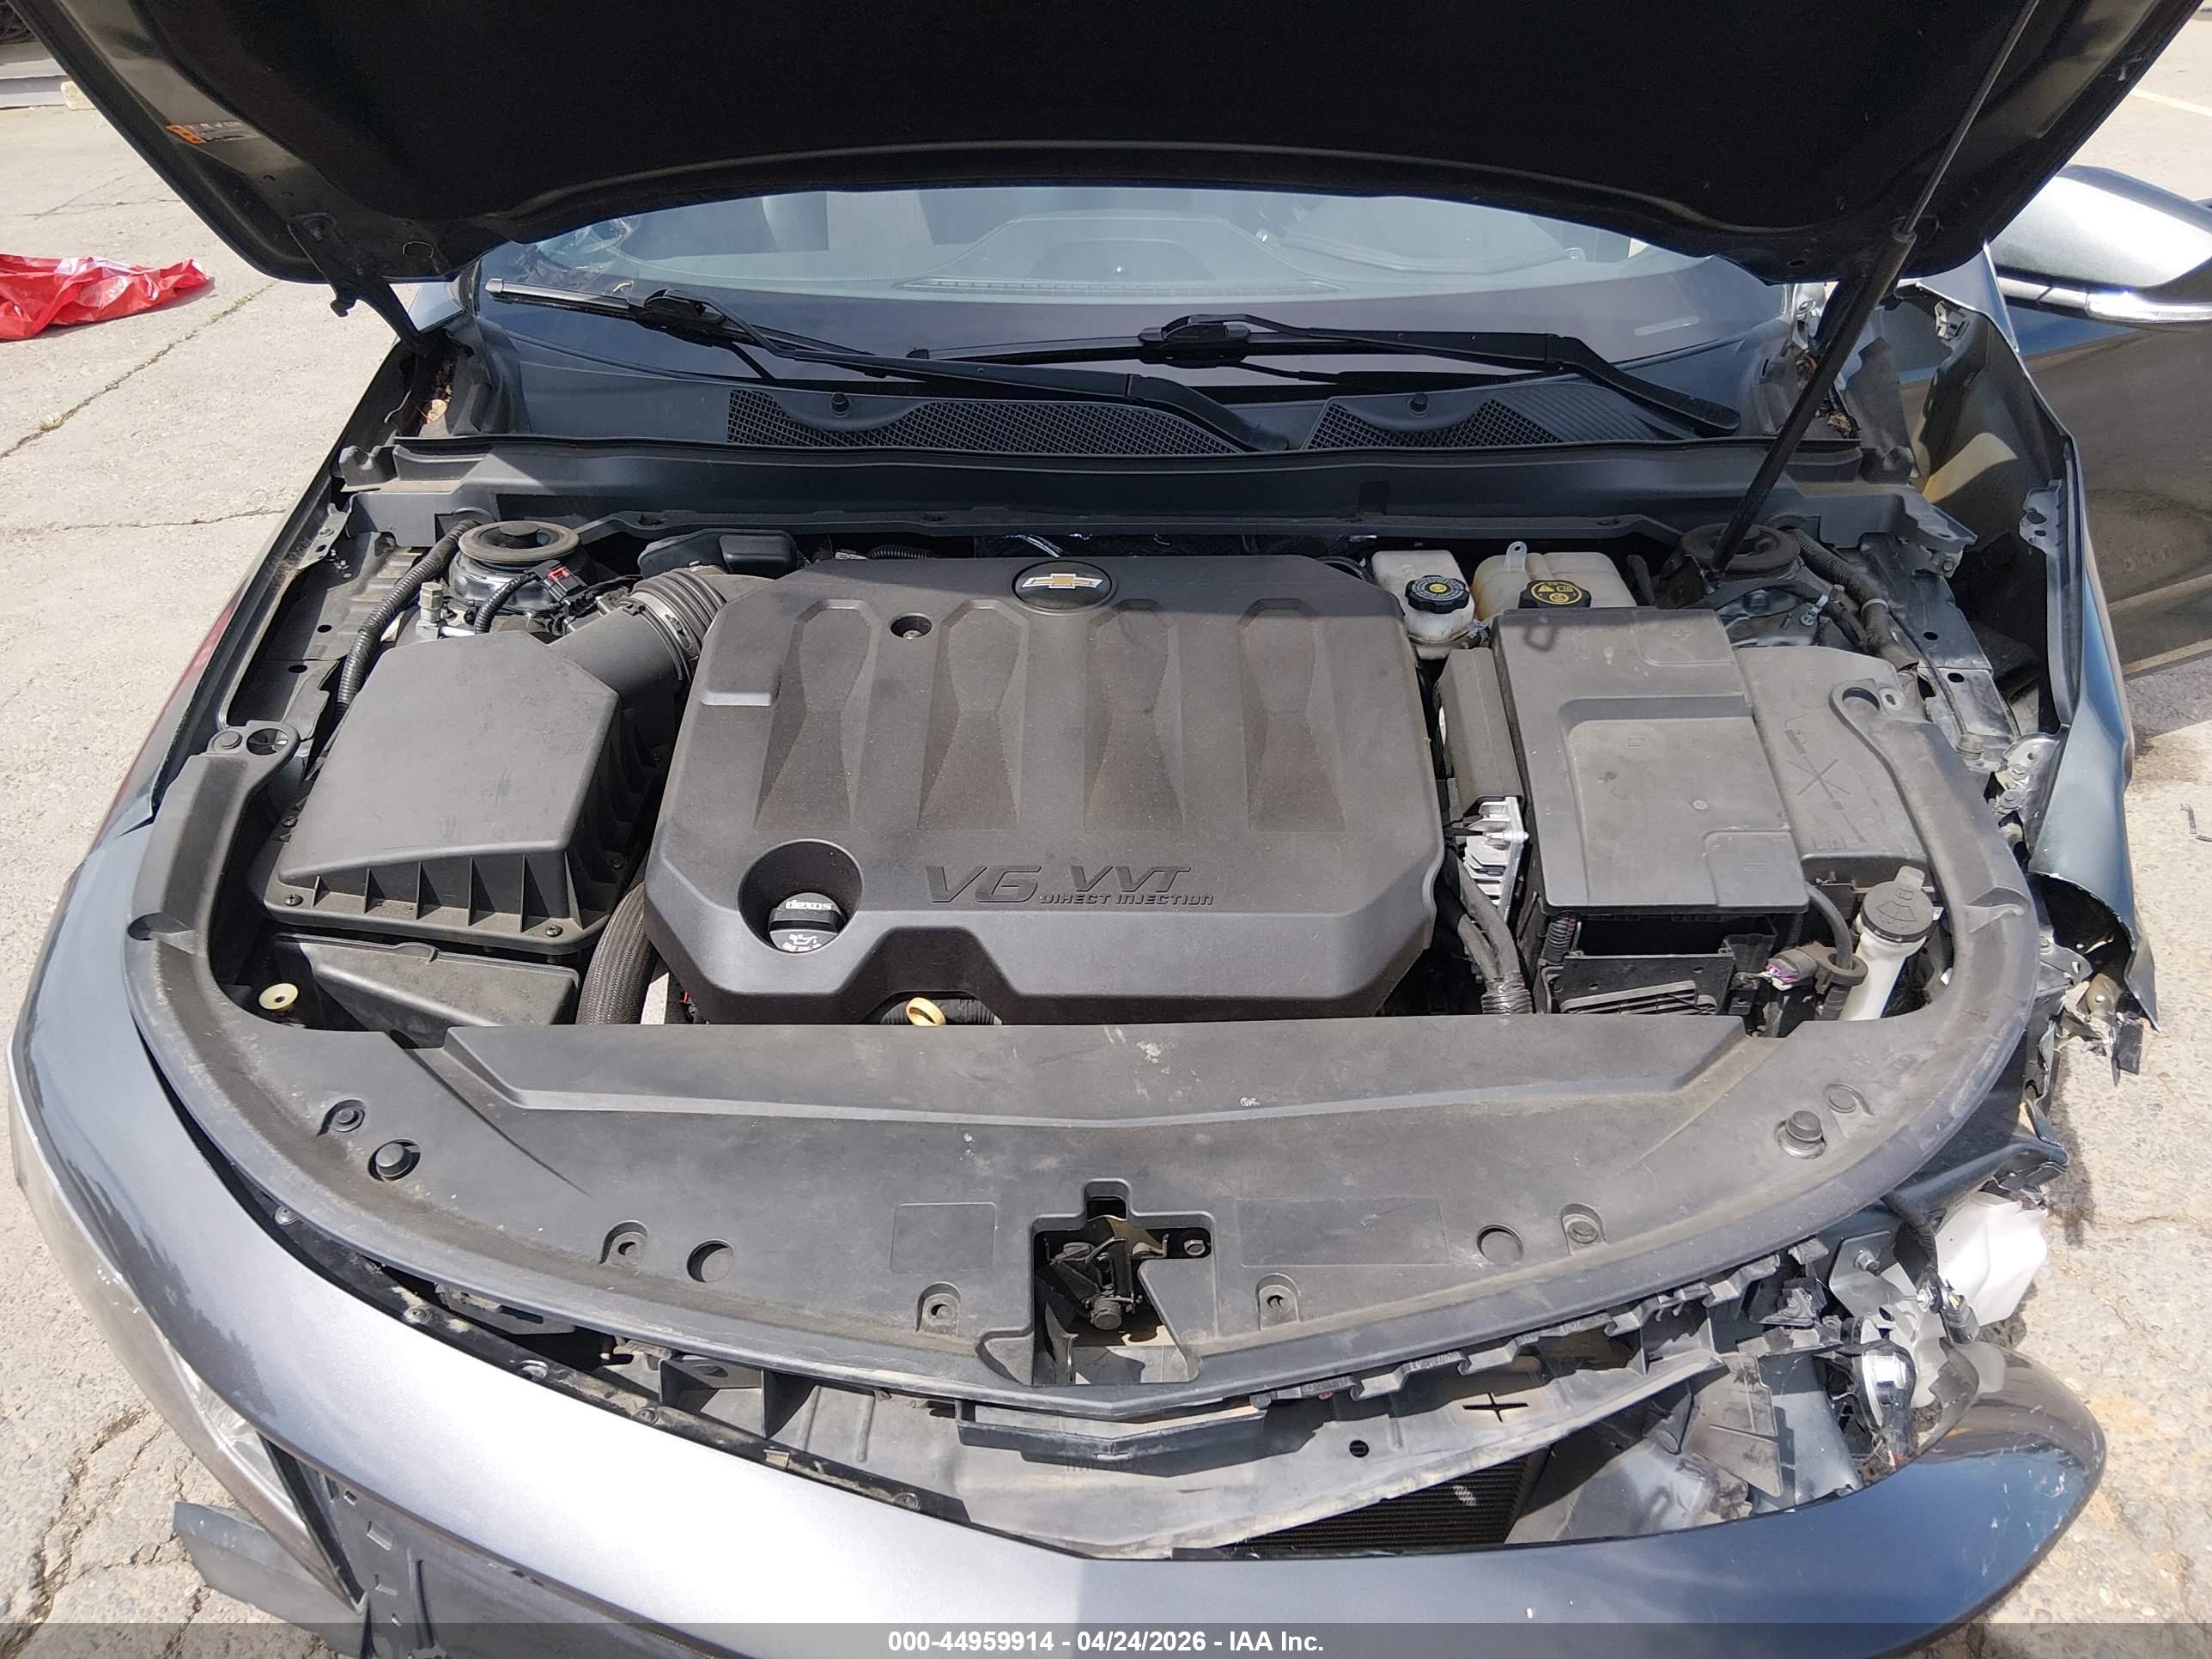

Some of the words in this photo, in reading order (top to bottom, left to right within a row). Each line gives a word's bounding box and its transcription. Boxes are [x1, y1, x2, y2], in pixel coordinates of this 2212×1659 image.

[926, 866, 1042, 903] V6
[1072, 866, 1192, 893] VVT
[785, 899, 835, 911] dexos
[1040, 894, 1111, 905] DIRECT
[1116, 894, 1214, 906] INJECTION
